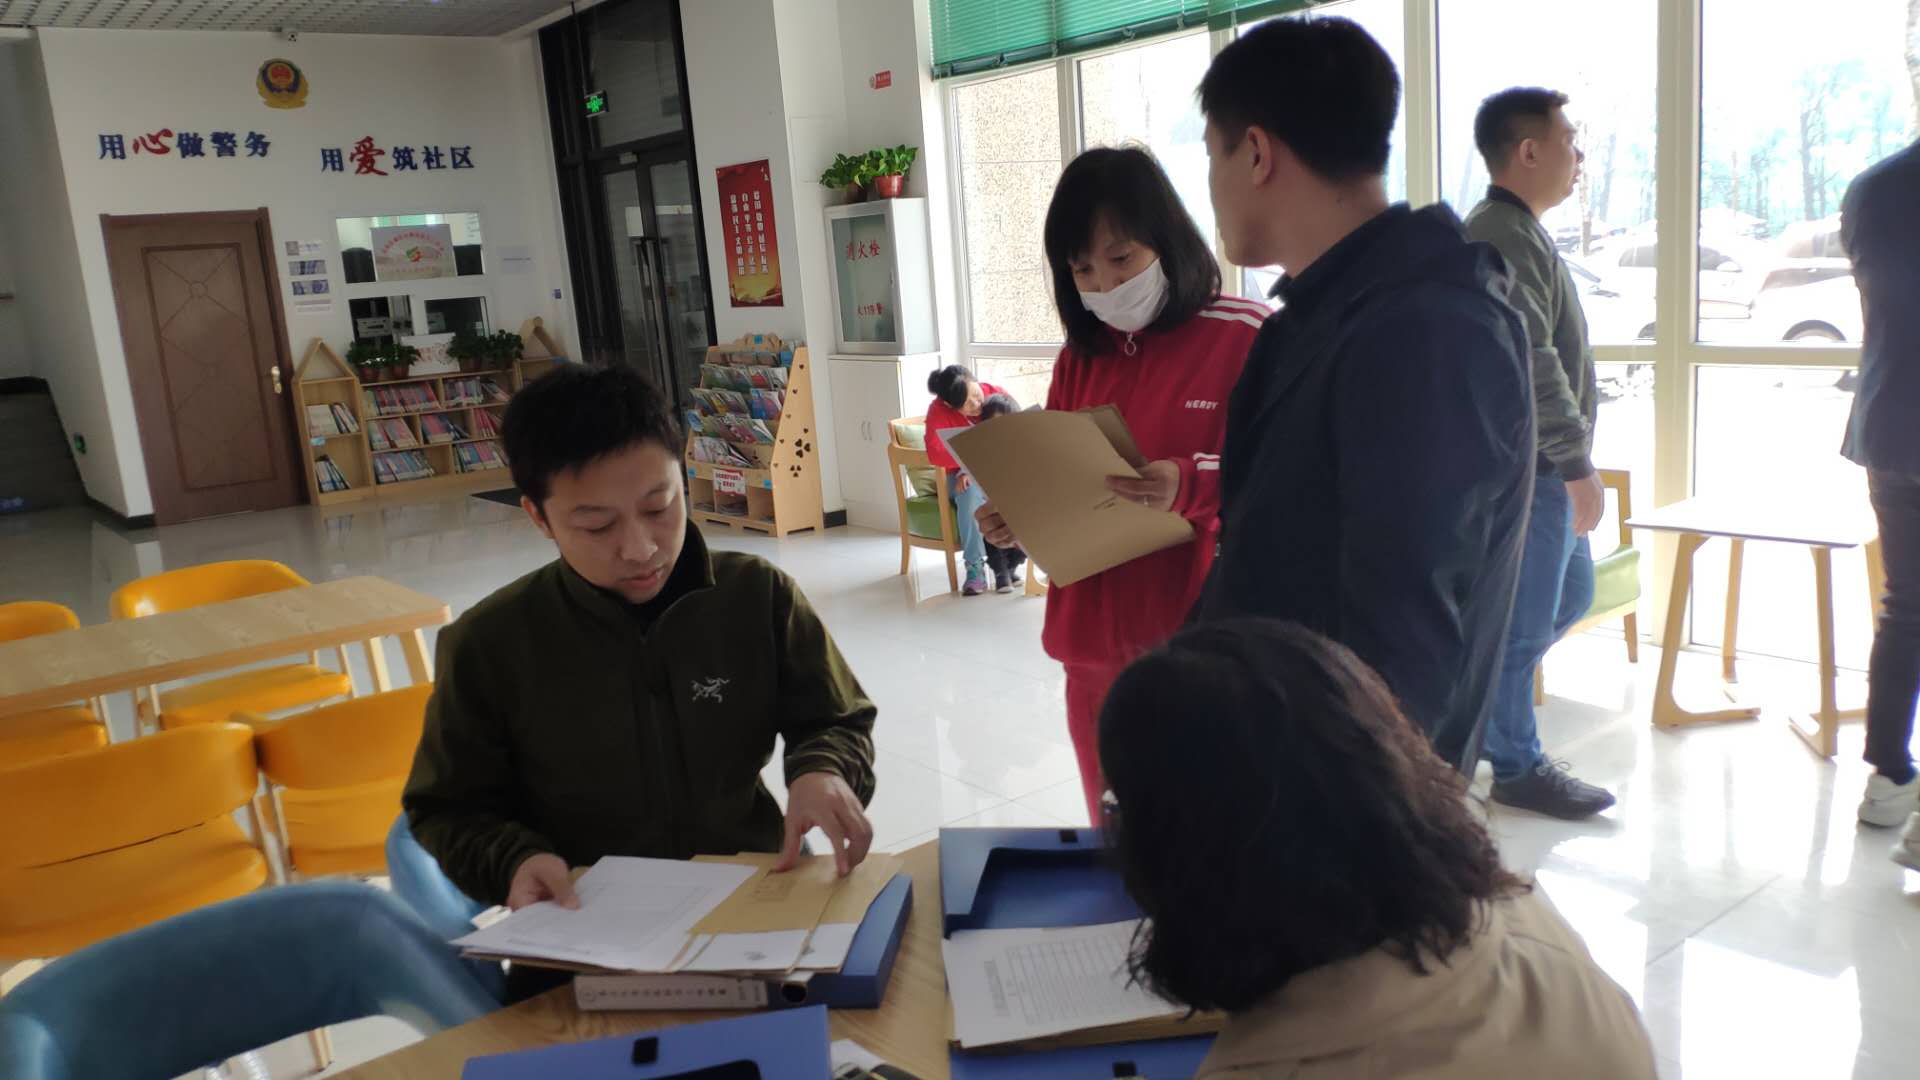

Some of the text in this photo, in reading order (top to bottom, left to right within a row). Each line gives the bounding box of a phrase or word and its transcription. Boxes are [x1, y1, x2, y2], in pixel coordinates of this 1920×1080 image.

[98, 129, 271, 160] 用心做警务
[320, 135, 475, 176] 用爱筑社区
